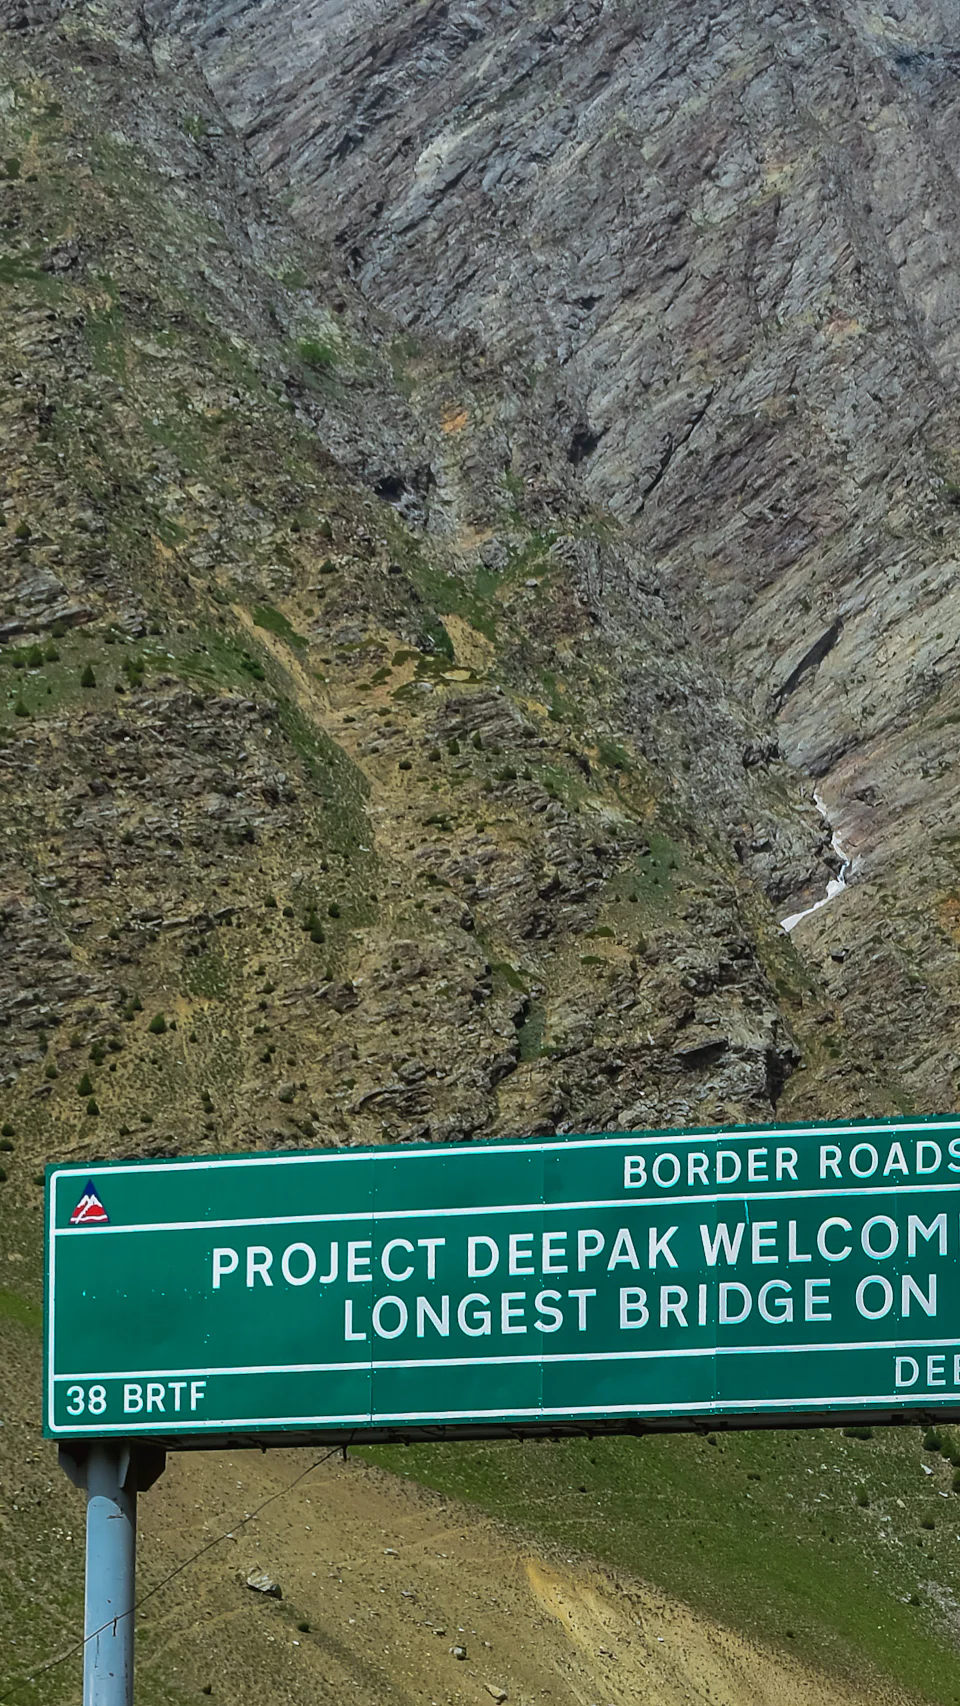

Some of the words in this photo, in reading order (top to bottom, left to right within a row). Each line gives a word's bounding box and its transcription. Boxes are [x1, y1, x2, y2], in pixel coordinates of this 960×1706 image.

[622, 1146, 799, 1188] BORDER
[211, 1236, 447, 1290] PROJECT
[466, 1225, 680, 1279] DEEPAK
[343, 1287, 598, 1342] LONGEST
[618, 1277, 833, 1330] BRIDGE
[854, 1272, 938, 1321] ON
[65, 1383, 108, 1416] 38
[122, 1380, 207, 1414] BRTF
